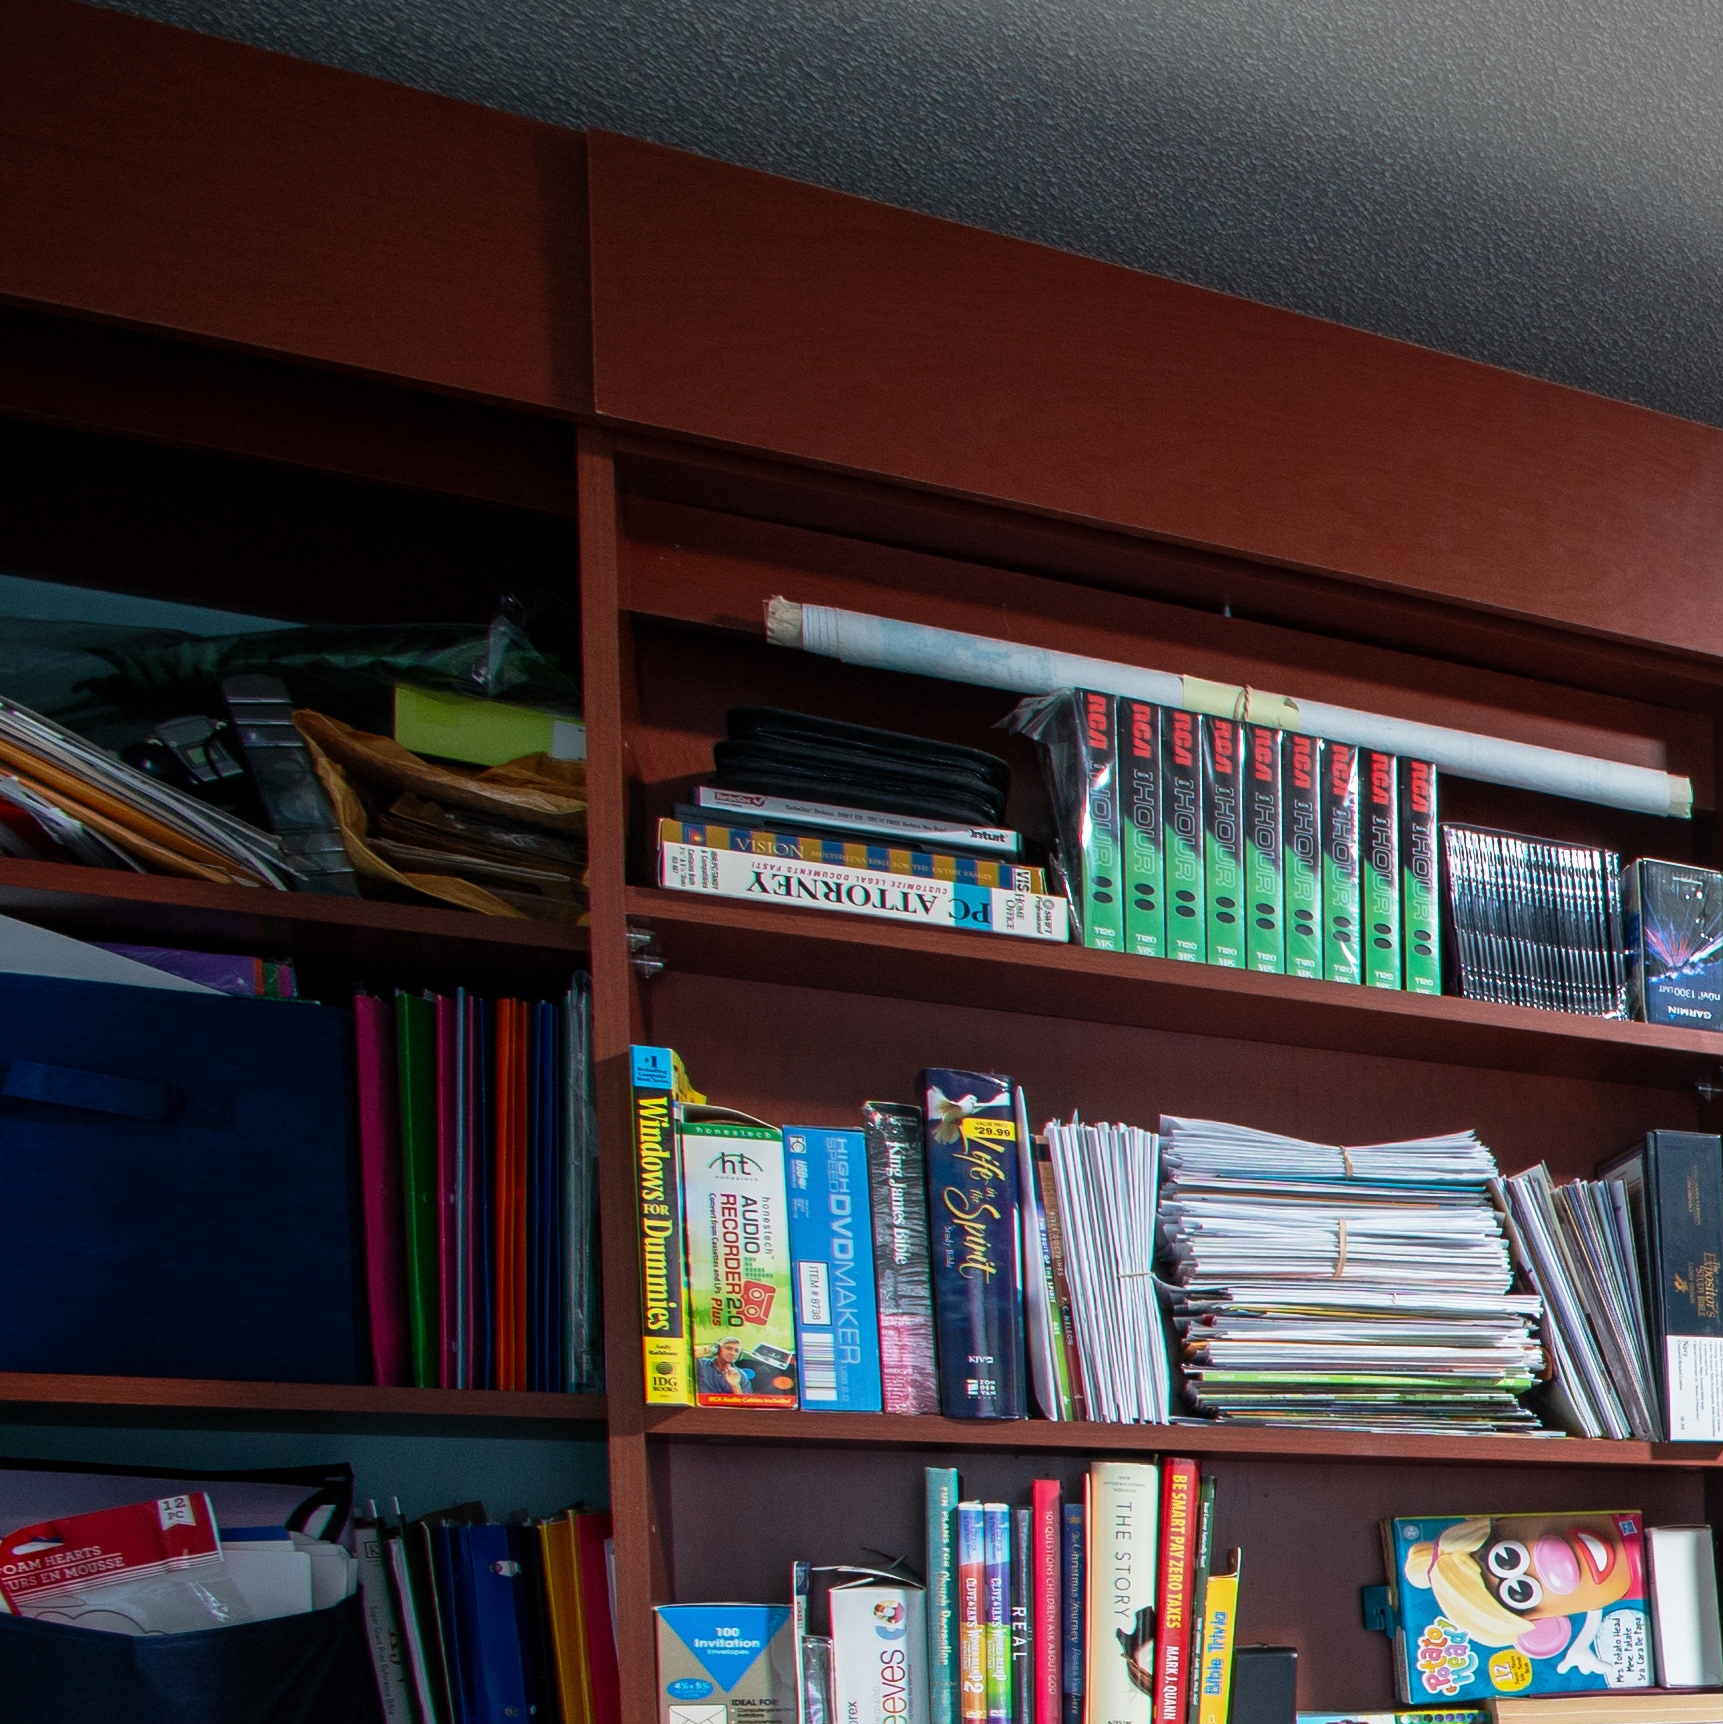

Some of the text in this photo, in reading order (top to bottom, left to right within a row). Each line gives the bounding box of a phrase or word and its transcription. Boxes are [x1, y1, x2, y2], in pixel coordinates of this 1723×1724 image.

[1087, 693, 1107, 750] RCA
[1133, 703, 1151, 758] RCA
[1173, 711, 1192, 766] RCA
[1215, 719, 1232, 774] RCA
[736, 838, 804, 859] VISION
[746, 870, 937, 916] ATTORNEY
[751, 862, 947, 895] CUSTOMIZE LEGAL DOCUMENTS FAST!
[948, 897, 992, 926] PC
[1007, 900, 1015, 930] OFFICE
[1668, 1006, 1712, 1019] GARMIN
[638, 1096, 669, 1200] Windows
[826, 1137, 838, 1192] SPEED
[838, 1138, 849, 1192] HIGH
[954, 1137, 1005, 1180] Life
[643, 1204, 669, 1216] FOR
[889, 1142, 910, 1265] King James Bible
[742, 1196, 760, 1254] AUDIO
[762, 1196, 774, 1260] honestech
[943, 1187, 1001, 1284] Spirit
[643, 1218, 677, 1331] Dummies
[721, 1194, 744, 1327] RECORDER 2.0
[653, 1376, 677, 1386] IDG
[163, 1498, 186, 1510] 12
[168, 1511, 184, 1520] PC
[42, 1558, 124, 1583] EN MOUSSE
[1045, 1526, 1054, 1575] QUESTIONS
[1114, 1502, 1132, 1619] THE STORY
[1166, 1474, 1188, 1628] BE SMART PAY ZERO TAXES
[1046, 1578, 1055, 1621] CHILDREN
[694, 1639, 760, 1648] Invitation
[716, 1627, 739, 1636] 100
[1012, 1607, 1027, 1660] REAL
[1047, 1624, 1056, 1640] ASK
[1208, 1612, 1228, 1653] Trivia
[1612, 1618, 1623, 1683] Mrs. Potato Head
[1635, 1637, 1643, 1646] De
[1047, 1643, 1056, 1672] ABOUT
[1166, 1646, 1179, 1674] MARK
[1204, 1659, 1224, 1696] Bible
[1418, 1626, 1453, 1690] Potato
[1443, 1631, 1477, 1686] Head
[1494, 1663, 1512, 1681] 12
[1636, 1648, 1644, 1665] Cara
[964, 1681, 983, 1693] 2
[1048, 1675, 1056, 1694] GOD
[1163, 1686, 1178, 1720] QUANN
